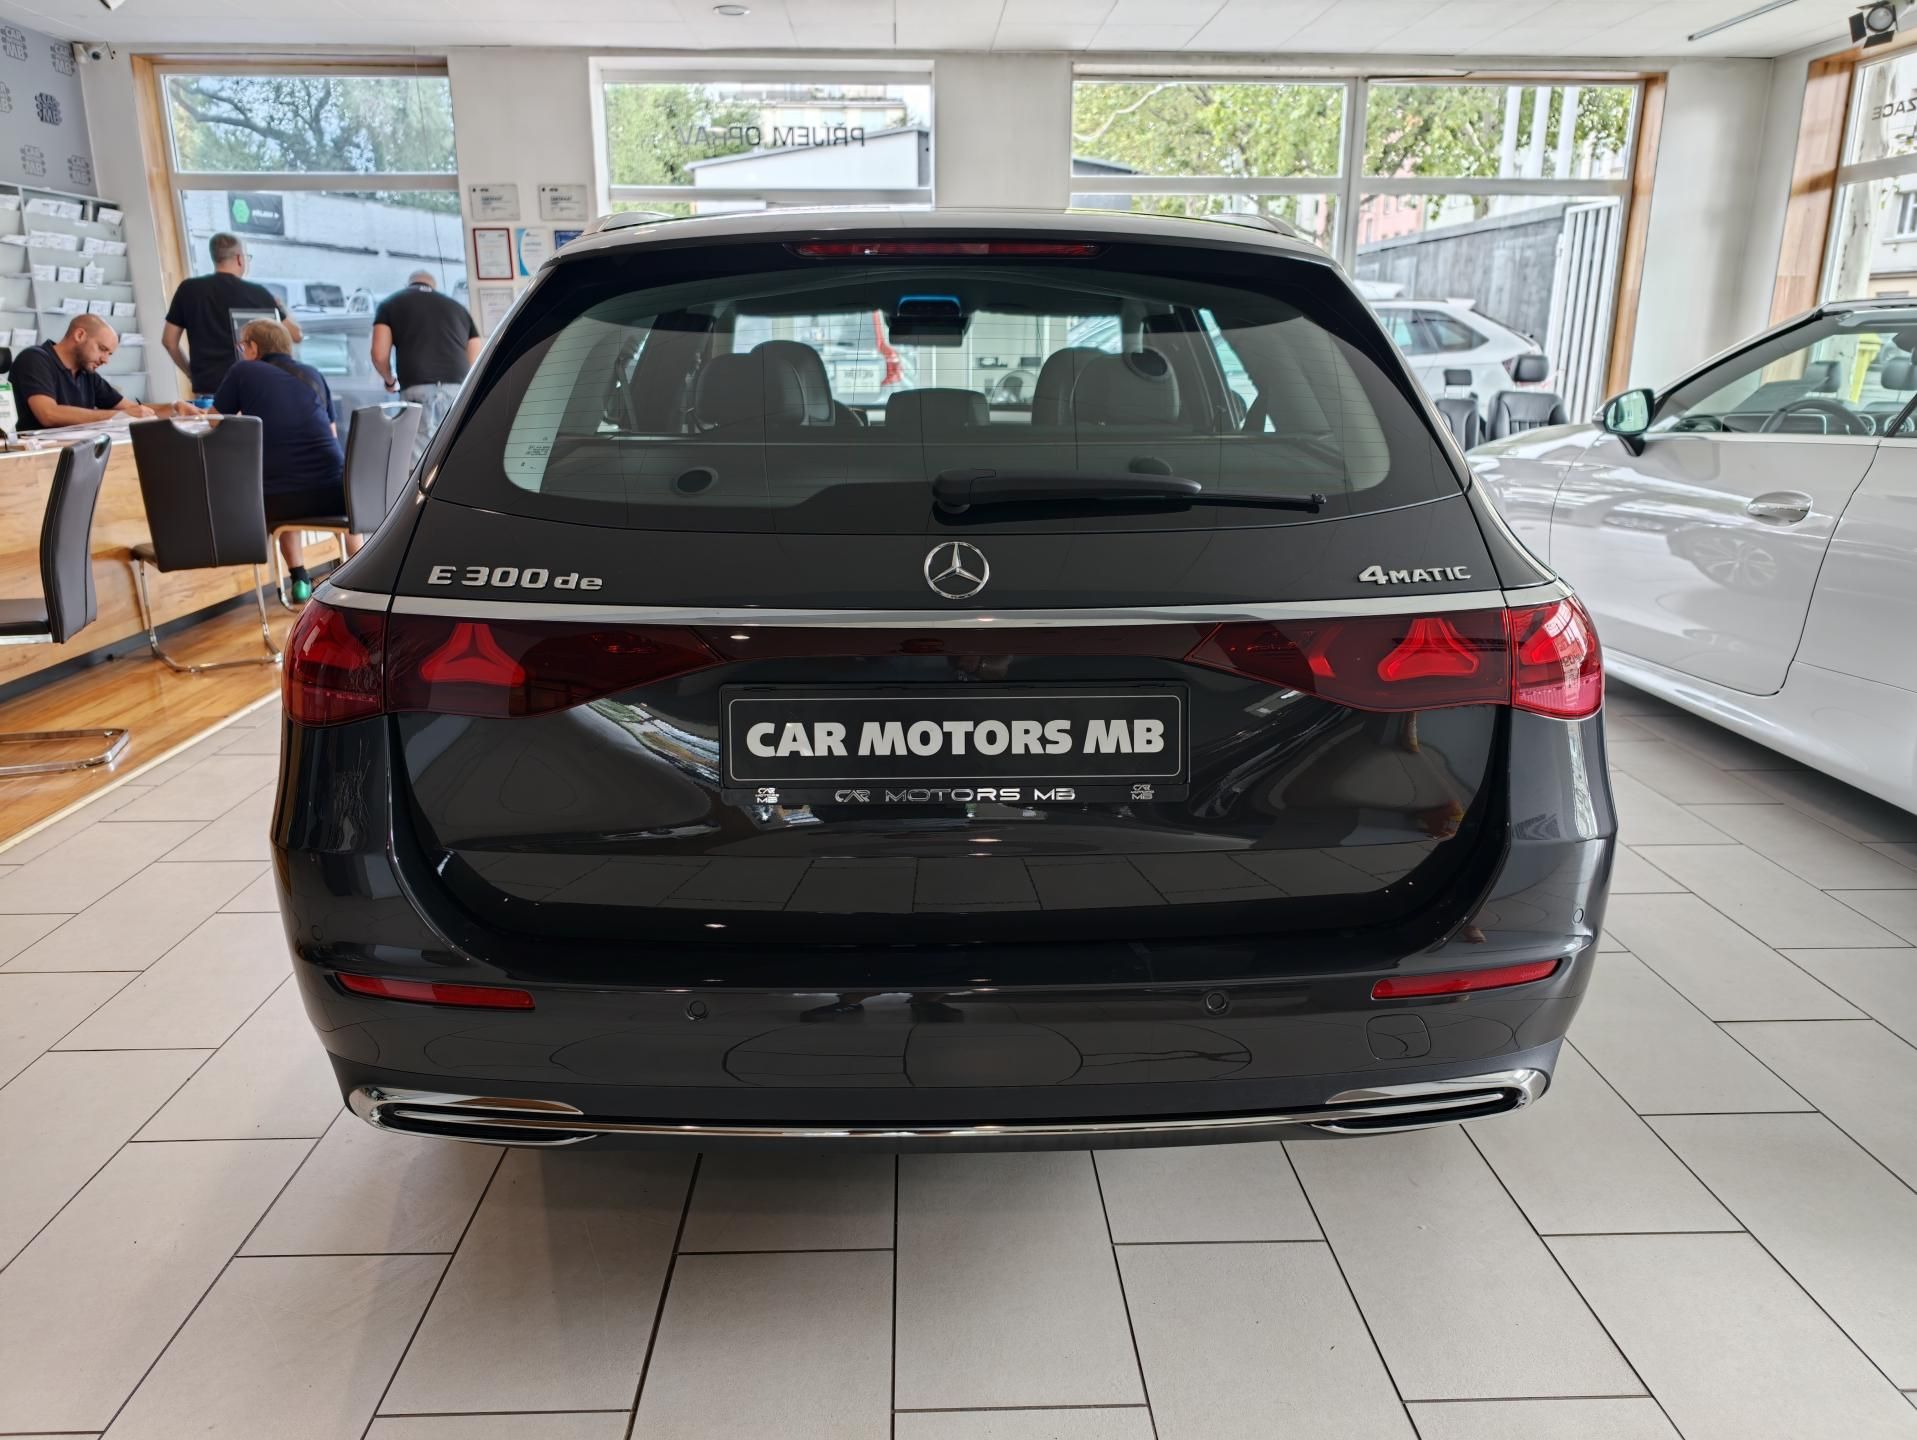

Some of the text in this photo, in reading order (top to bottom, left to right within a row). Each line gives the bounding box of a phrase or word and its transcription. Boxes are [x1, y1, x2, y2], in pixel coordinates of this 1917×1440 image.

[427, 565, 603, 590] E 300 de
[1359, 565, 1472, 585] 4MATIC
[746, 719, 1165, 758] CAR MOTORS MB
[756, 796, 778, 804] MB
[835, 787, 1076, 803] CAR MOTORS MB
